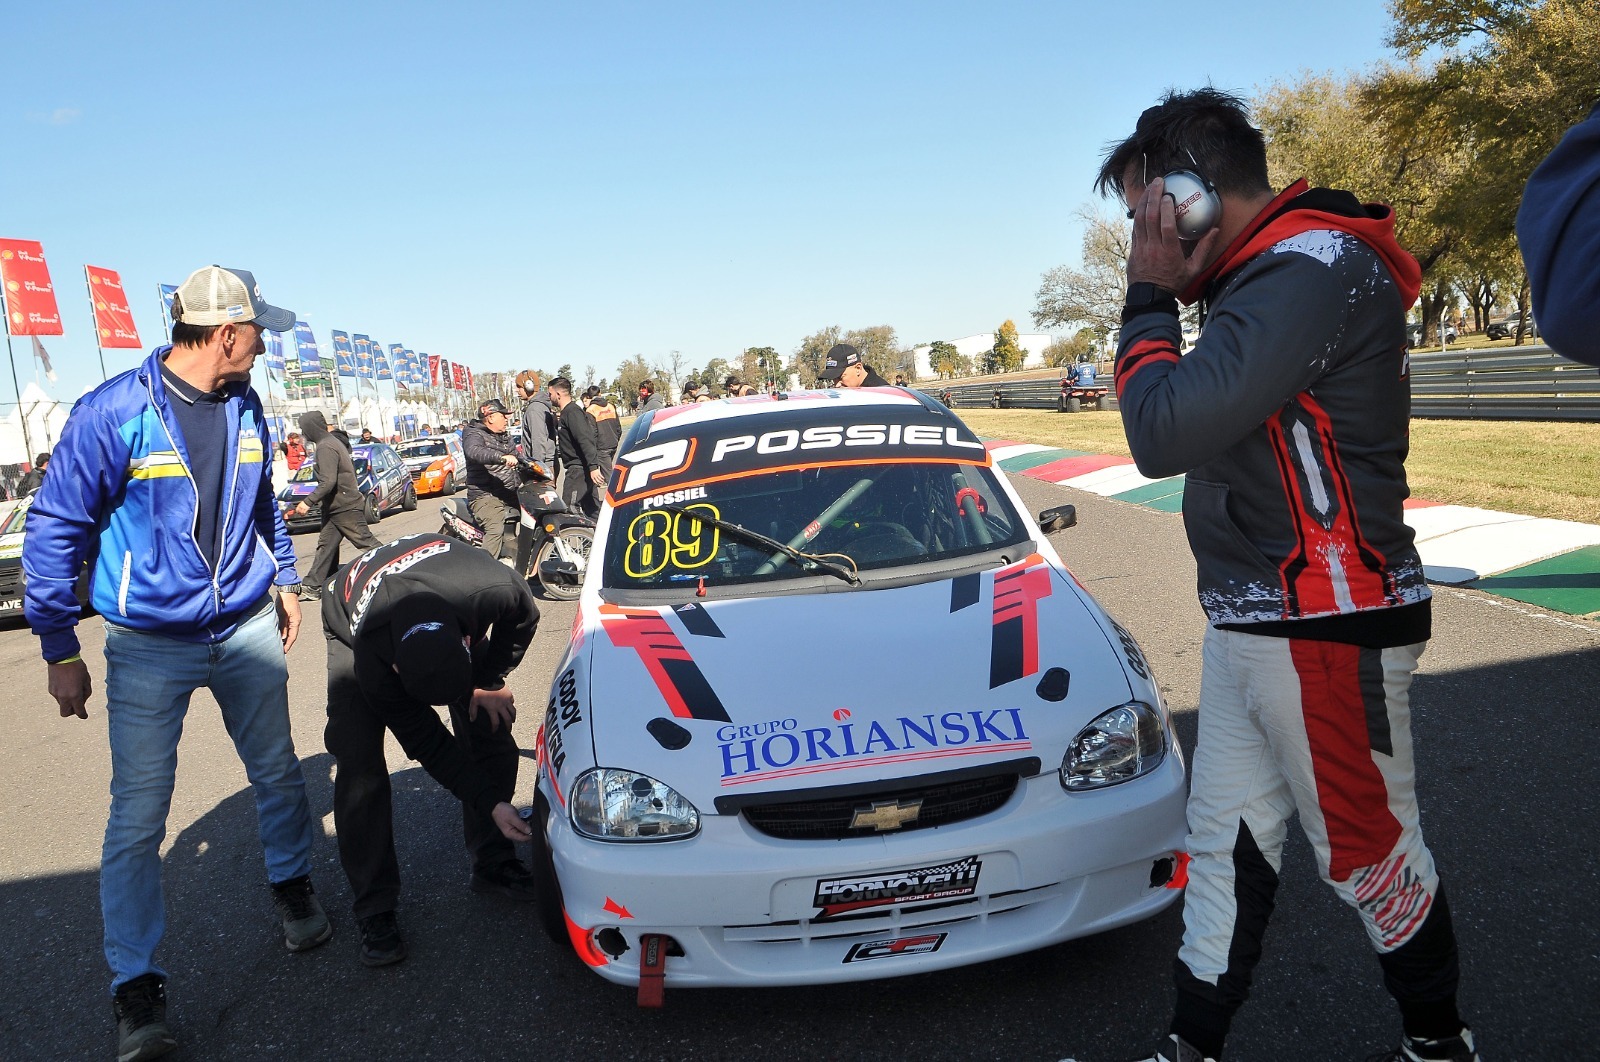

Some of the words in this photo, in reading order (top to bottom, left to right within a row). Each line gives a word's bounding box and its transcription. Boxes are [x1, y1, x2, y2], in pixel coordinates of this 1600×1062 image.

[711, 424, 985, 463] POSSIEL
[643, 486, 708, 510] POSSIEL
[624, 503, 720, 578] 89
[559, 668, 582, 730] GODOY
[716, 718, 798, 742] GRUPO
[717, 708, 1030, 778] HORIANSKI
[894, 893, 932, 903] SPORT
[933, 887, 973, 898] GROUP
